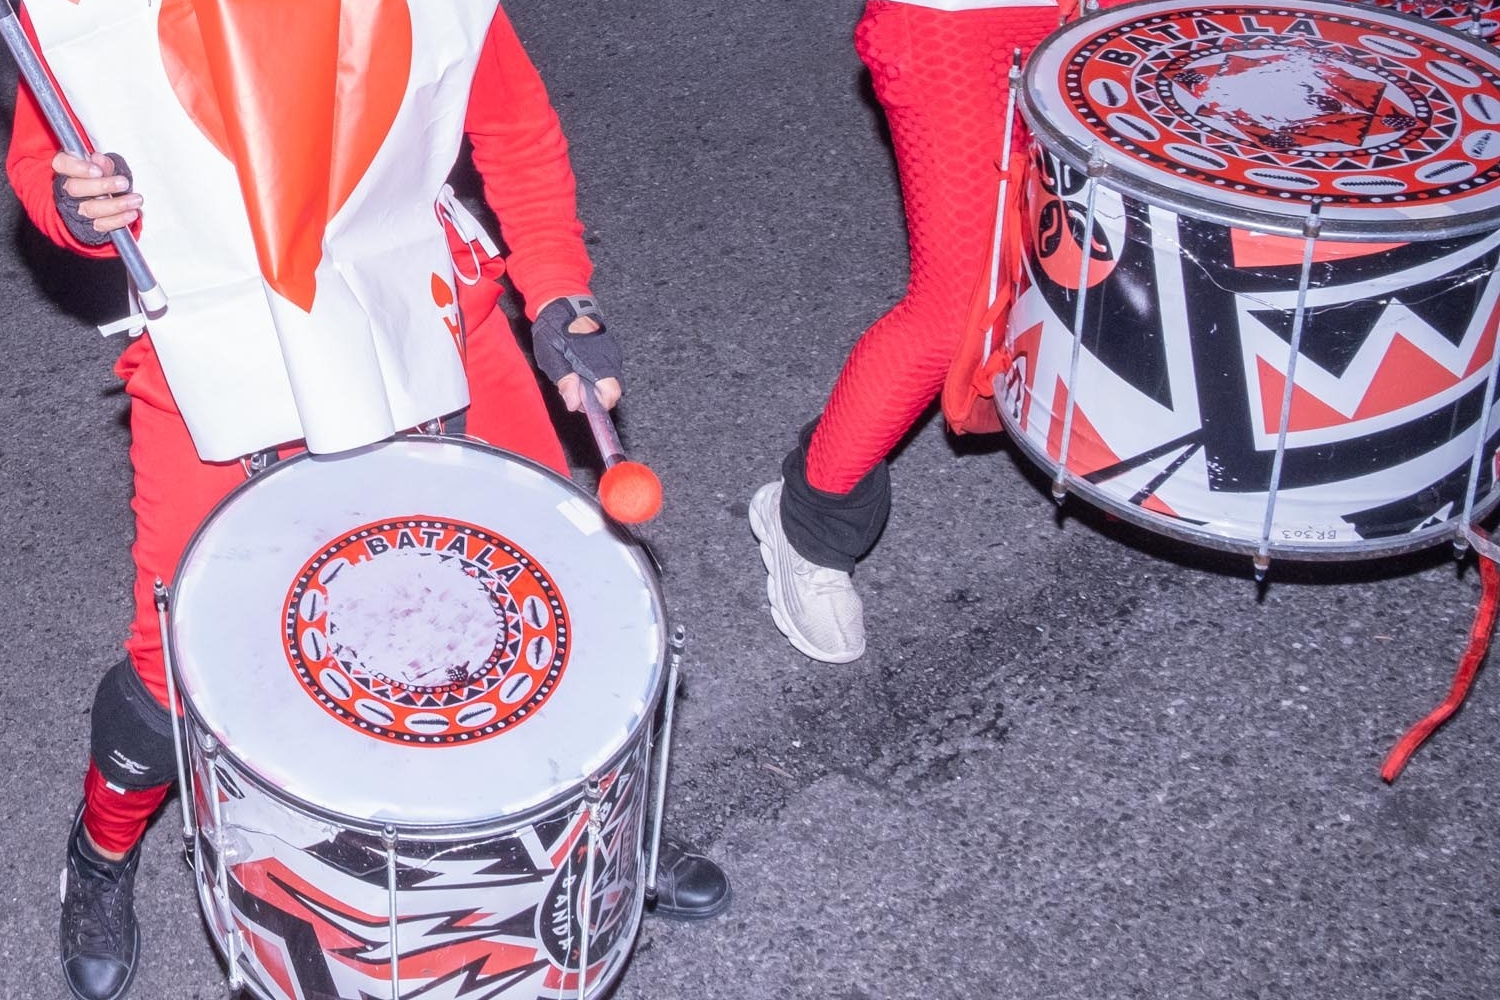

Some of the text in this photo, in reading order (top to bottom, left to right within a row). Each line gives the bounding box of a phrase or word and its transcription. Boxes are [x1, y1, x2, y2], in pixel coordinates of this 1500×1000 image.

[1097, 15, 1323, 68] BATALA
[365, 528, 524, 587] BATALA
[1281, 529, 1337, 541] BR303
